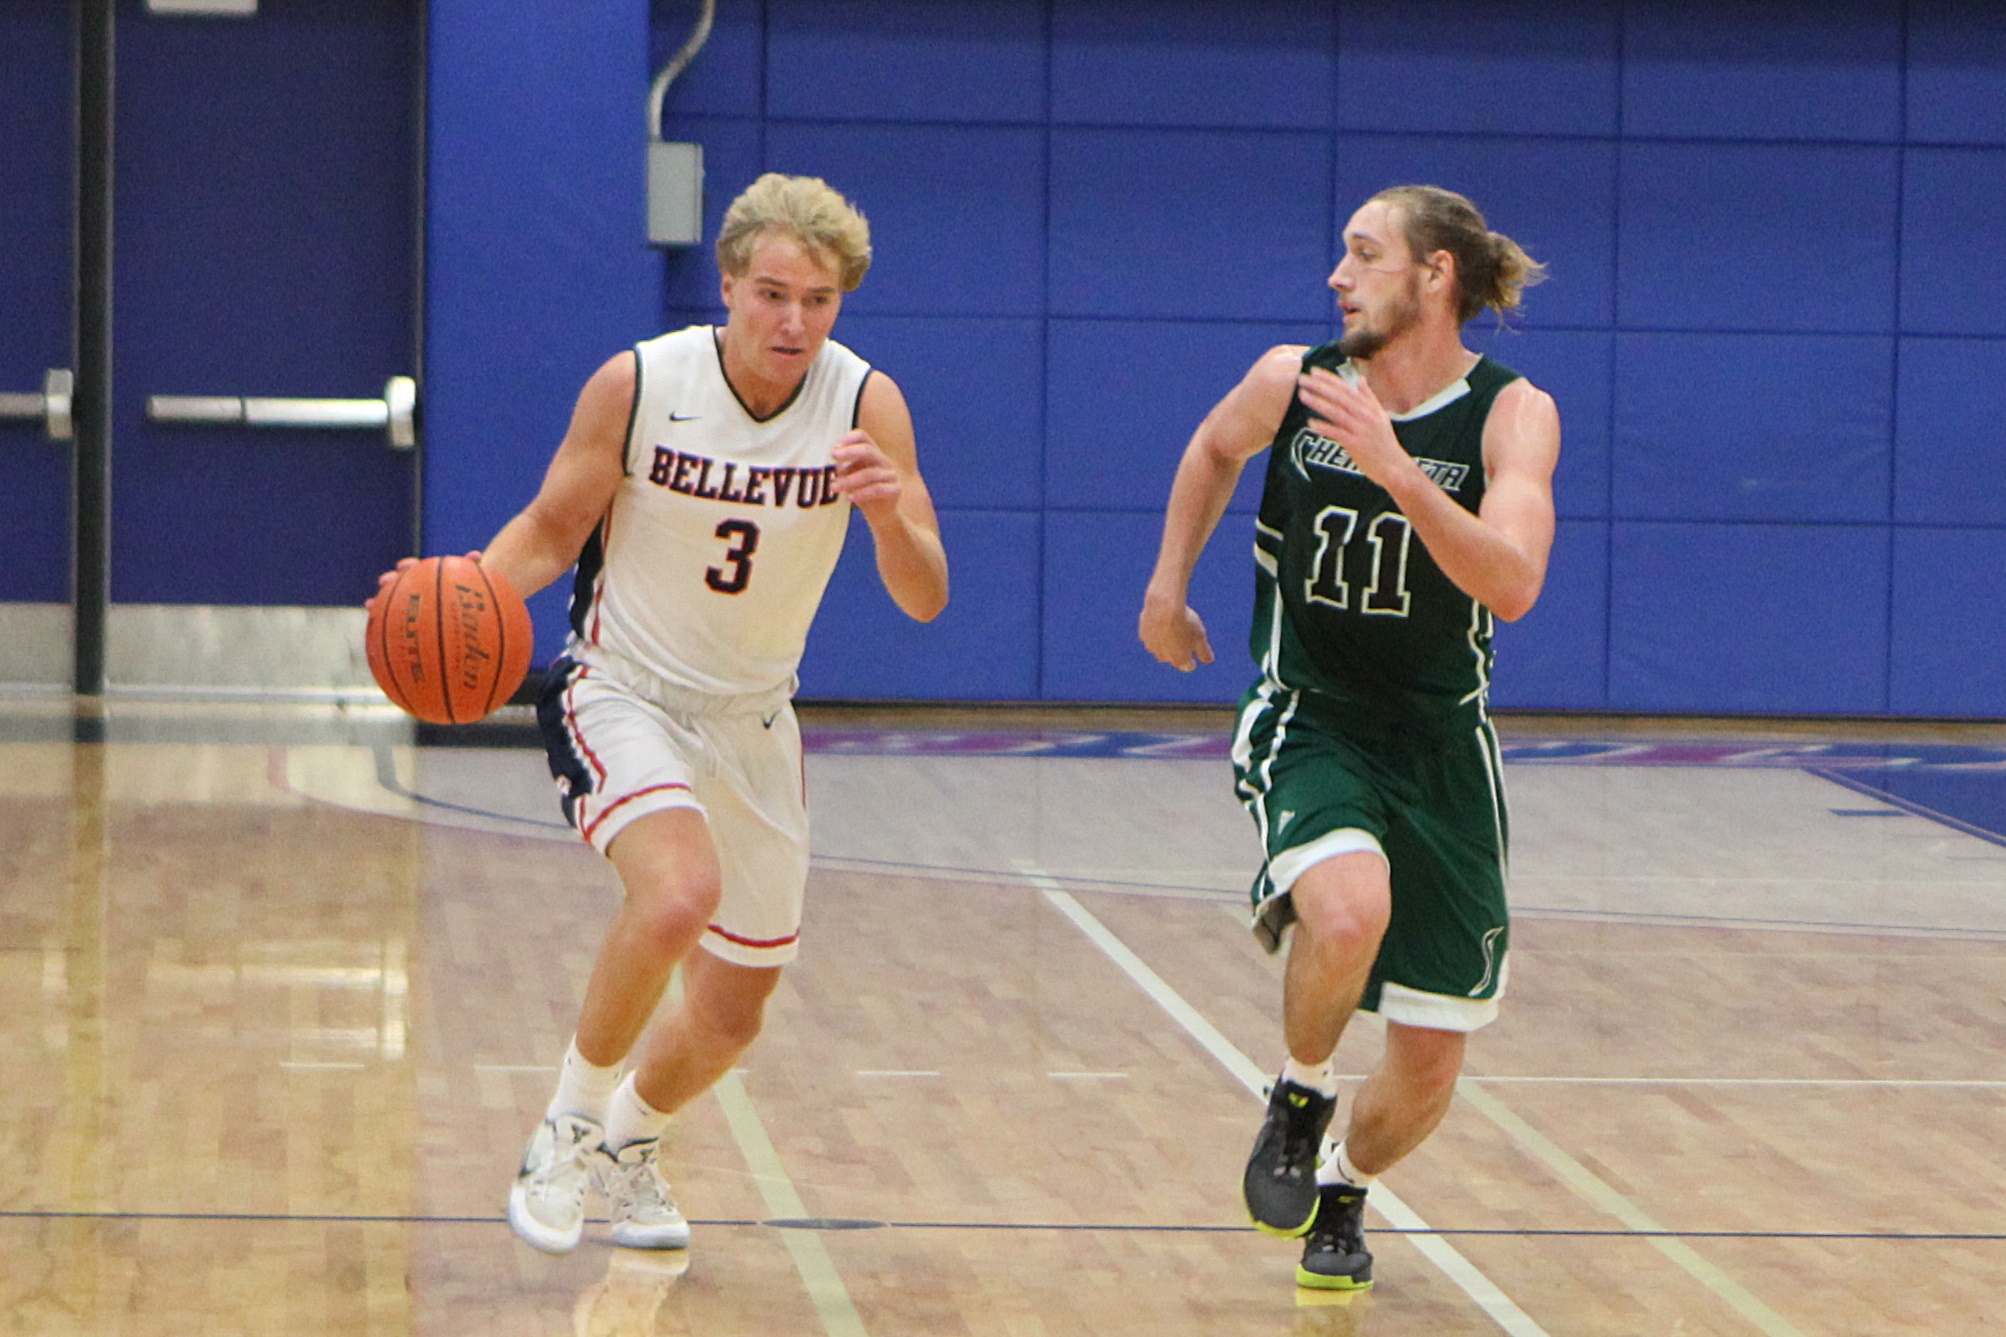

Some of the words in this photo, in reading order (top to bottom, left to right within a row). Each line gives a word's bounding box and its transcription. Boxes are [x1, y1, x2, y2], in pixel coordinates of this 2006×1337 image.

[648, 444, 840, 509] BELLEVUE
[1290, 427, 1470, 491] CHETA
[704, 518, 761, 595] 3
[1304, 505, 1411, 618] 11
